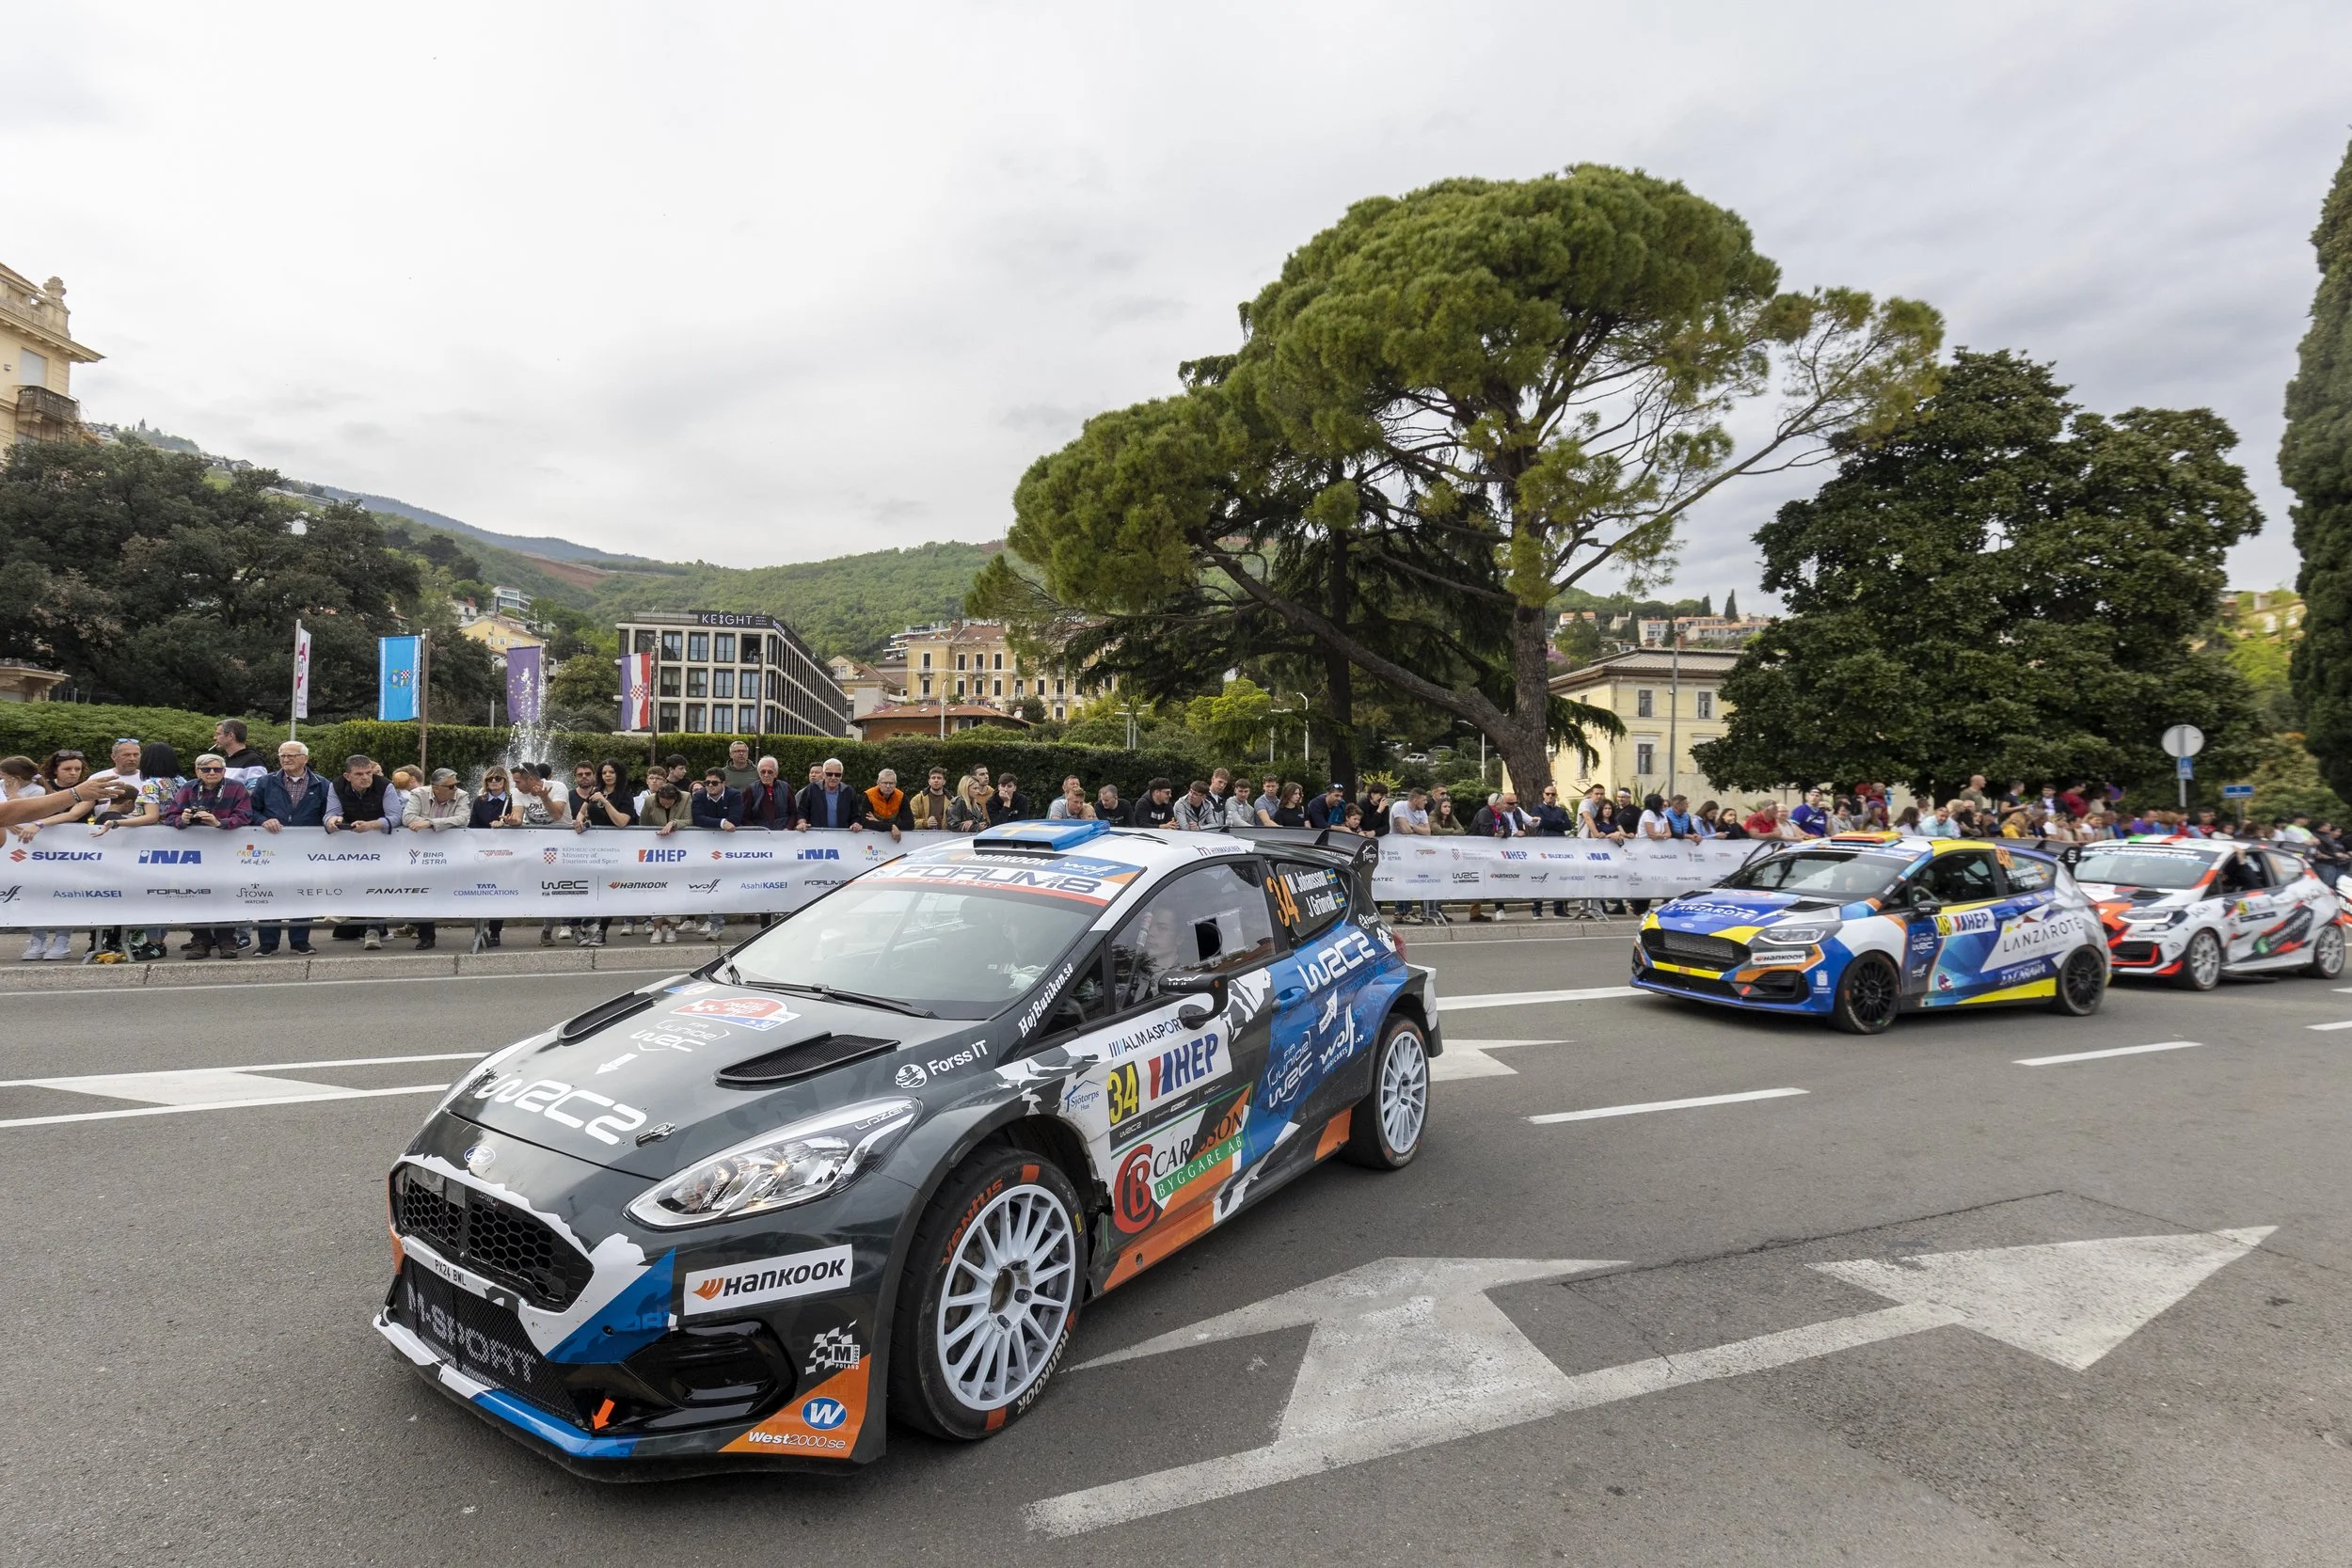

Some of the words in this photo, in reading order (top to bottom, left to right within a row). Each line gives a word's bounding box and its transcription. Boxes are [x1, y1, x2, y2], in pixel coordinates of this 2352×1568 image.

[31, 851, 102, 861] SUZUKI
[138, 849, 201, 864] INA
[655, 849, 687, 863] HEP
[797, 848, 839, 860] INA
[1512, 850, 1528, 860] HEP
[542, 879, 589, 890] WRC
[895, 865, 1103, 895] FORUM8
[53, 890, 122, 898] AsahiKASEI
[236, 887, 274, 898] STOWA
[1265, 875, 1302, 927] 34
[1668, 905, 1756, 920] LANZAROTE
[1967, 912, 1989, 930] HEP
[2003, 916, 2084, 953] LANZAROTE
[1912, 942, 1934, 951] WRC
[1296, 931, 1375, 993] WRC2
[629, 1029, 707, 1053] WRC
[927, 1050, 974, 1076] Forss
[971, 1039, 988, 1058] IT
[1172, 1033, 1218, 1087] HEP
[1271, 1040, 1310, 1086] JUNIOR
[1268, 1052, 1313, 1108] WRC
[1071, 1090, 1100, 1108] Sjötorps
[1106, 1064, 1138, 1125] 34
[474, 1073, 647, 1146] WRC2
[1120, 1121, 1142, 1138] WRC2
[1157, 1148, 1222, 1197] BYGGARE
[1228, 1135, 1243, 1153] AB
[435, 1259, 451, 1279] PX24
[453, 1269, 467, 1287] BWL
[834, 1345, 851, 1362] M
[810, 1403, 845, 1424] W
[748, 1431, 846, 1449] West2000.se
